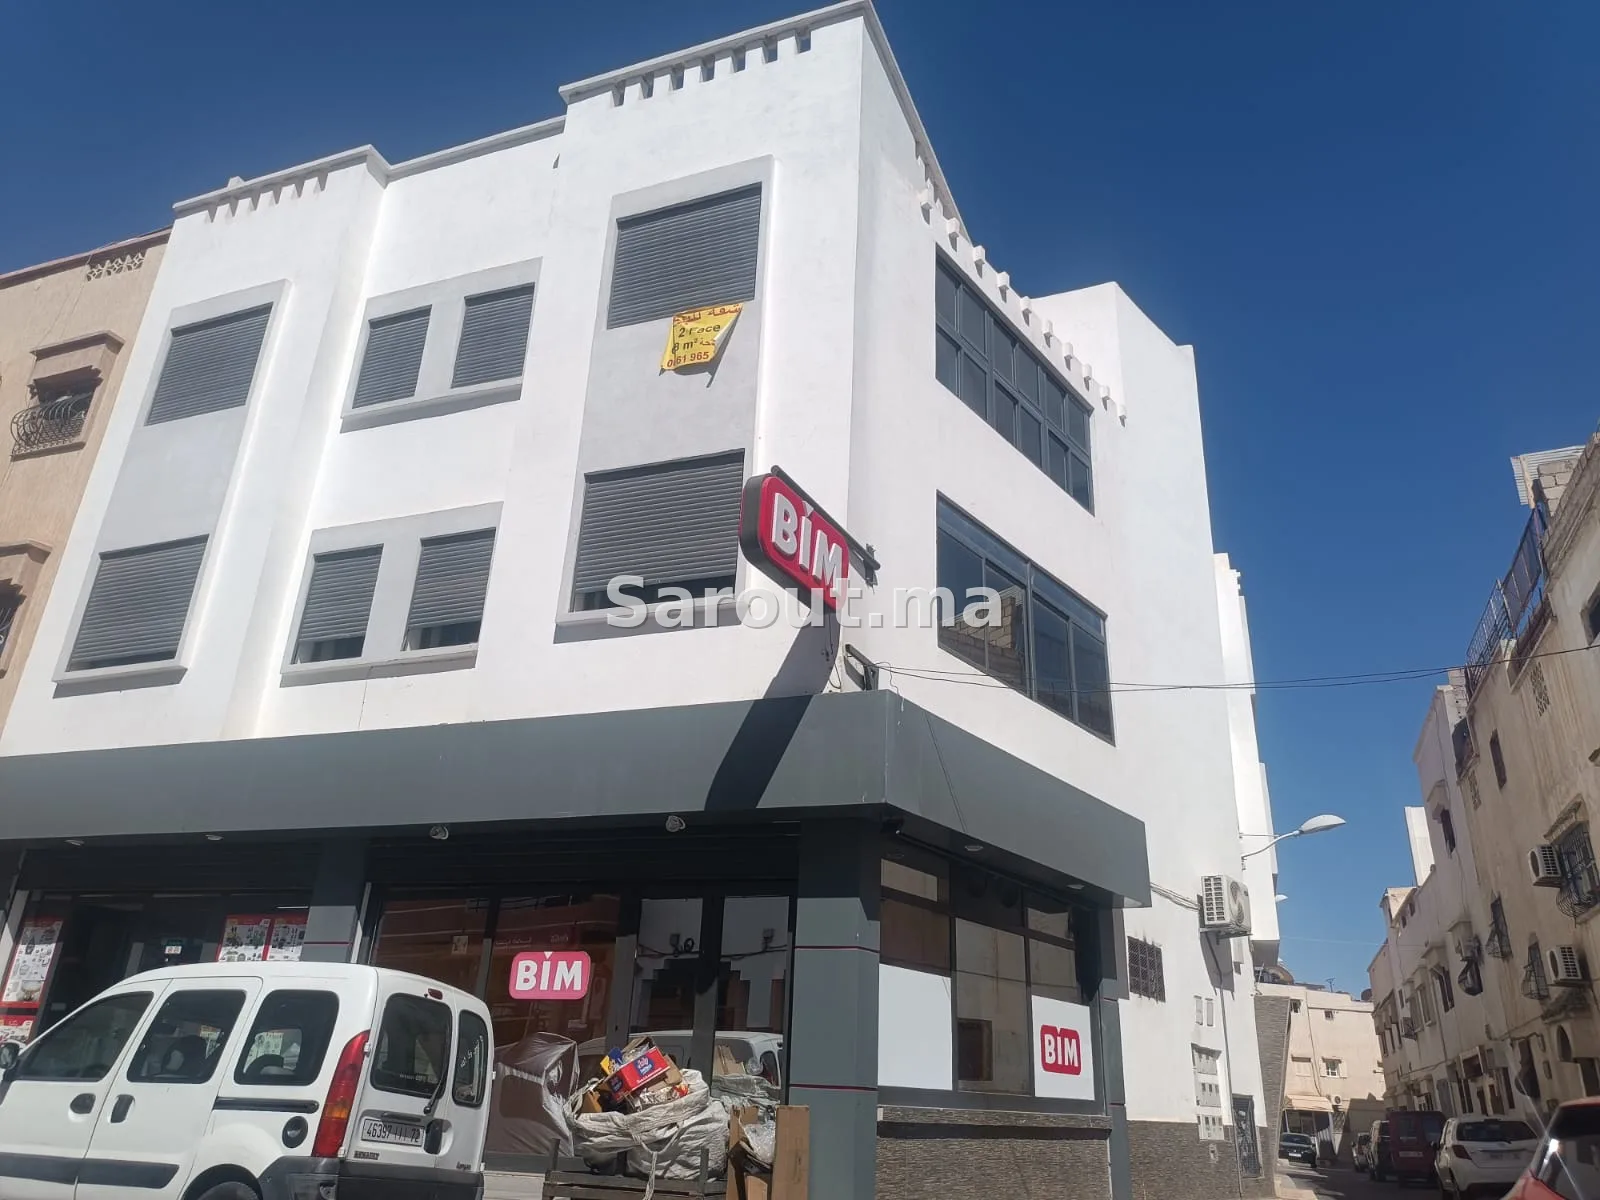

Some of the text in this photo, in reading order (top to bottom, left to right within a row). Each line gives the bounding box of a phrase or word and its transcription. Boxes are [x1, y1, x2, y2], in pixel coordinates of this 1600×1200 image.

[678, 327, 686, 338] 2
[690, 351, 709, 362] 965
[366, 1122, 392, 1139] 46397
[411, 1128, 421, 1142] 72
